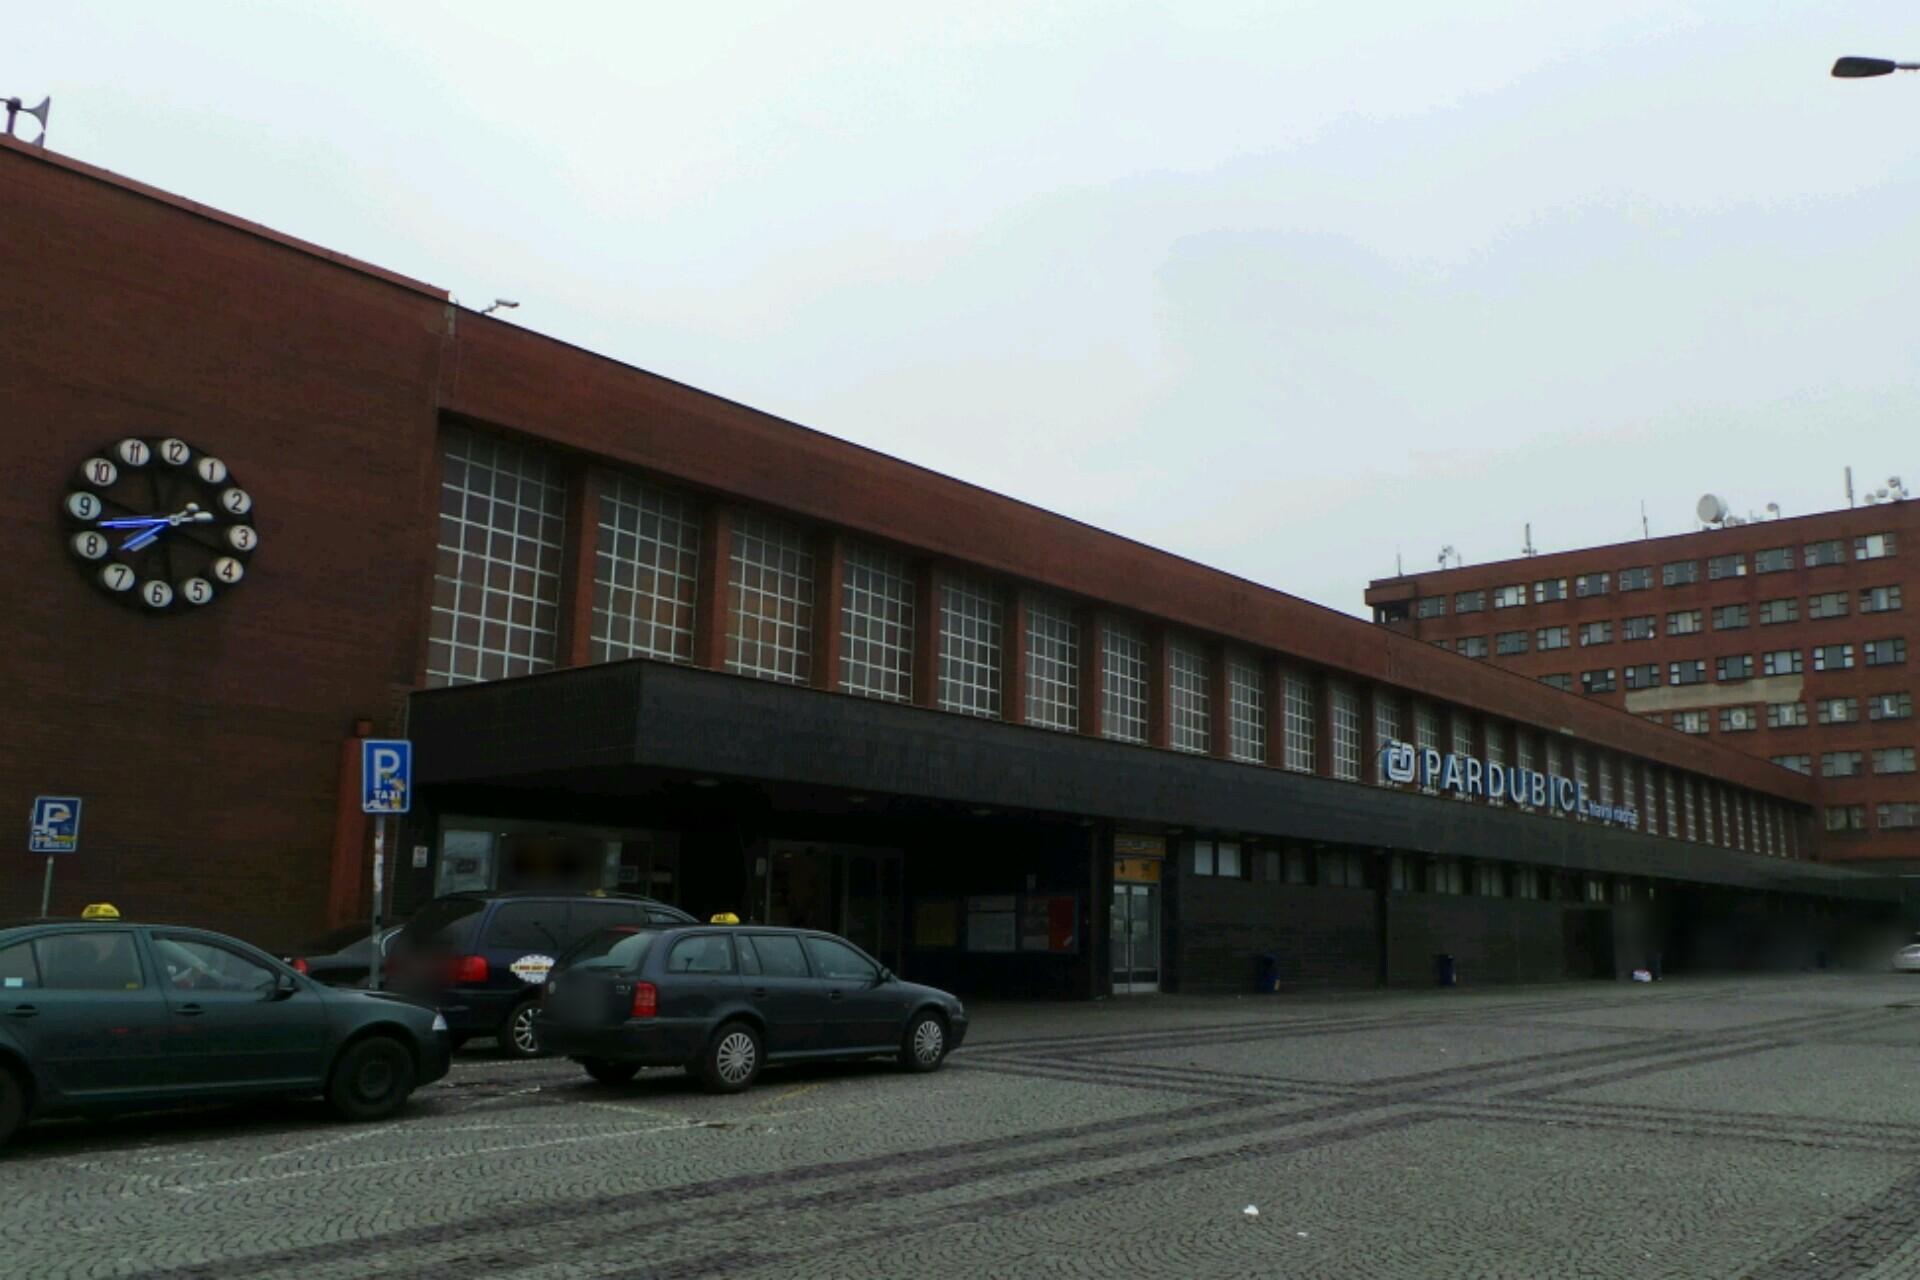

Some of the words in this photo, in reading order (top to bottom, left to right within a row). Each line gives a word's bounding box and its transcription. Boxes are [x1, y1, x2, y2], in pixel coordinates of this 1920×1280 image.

[129, 442, 142, 464] 11
[169, 442, 183, 463] 12
[93, 462, 110, 483] 10
[79, 496, 91, 516] 9
[231, 492, 242, 512] 2
[86, 535, 99, 555] 8
[237, 528, 249, 548] 3
[114, 567, 127, 588] 7
[222, 560, 233, 580] 4
[151, 583, 163, 603] 6
[192, 581, 204, 601] 5
[1685, 699, 1896, 733] HOTEL
[373, 748, 400, 789] P
[1421, 747, 1589, 814] PARDUBICE
[43, 803, 71, 834] P
